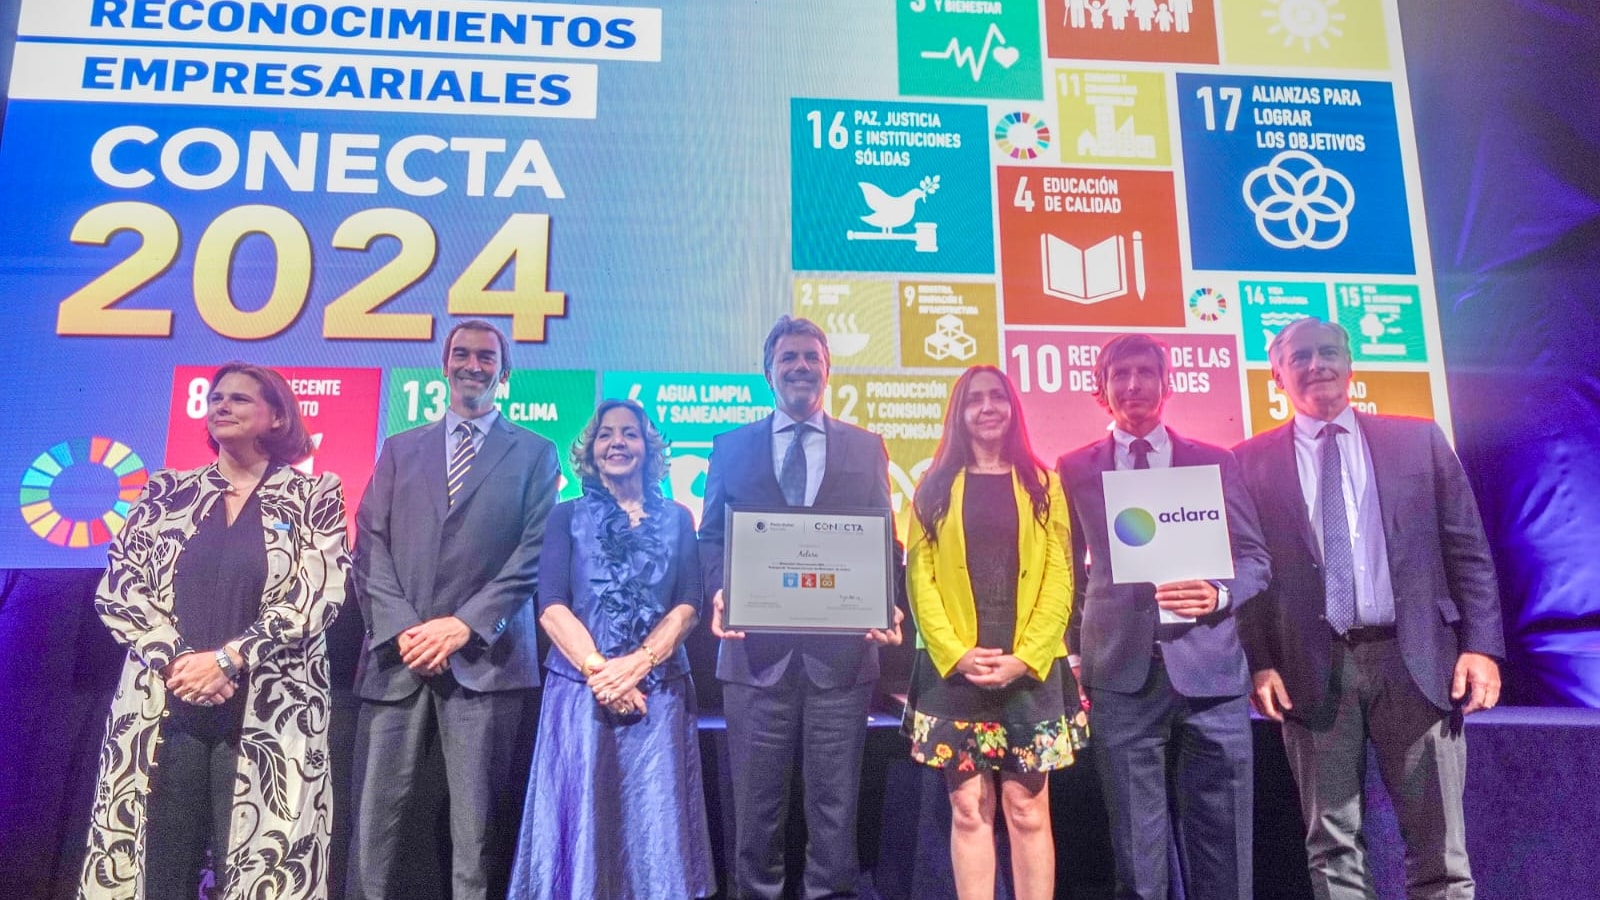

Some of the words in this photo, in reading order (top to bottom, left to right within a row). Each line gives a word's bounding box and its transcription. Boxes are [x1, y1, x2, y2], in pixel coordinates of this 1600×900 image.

[90, 0, 636, 49] RECONOCIMIENTOS
[81, 57, 572, 105] EMPRESARIALES
[1058, 73, 1080, 97] 11
[1252, 85, 1320, 104] ALIANZAS
[1323, 88, 1361, 106] PARA
[1196, 86, 1242, 131] 17
[1254, 108, 1312, 126] LOGRAR
[807, 110, 849, 149] 16
[885, 112, 941, 127] JUSTICIA
[854, 130, 863, 145] E
[866, 131, 961, 148] INSTITUCIONES
[1256, 131, 1285, 148] LOS
[1288, 132, 1365, 151] OBJETIVOS
[91, 125, 565, 198] CONECTA
[855, 148, 910, 166] SÓLIDAS
[1014, 176, 1035, 212] 4
[1043, 176, 1118, 194] EDUCACIÓN
[1044, 195, 1062, 212] DE
[1065, 196, 1122, 213] CALIDAD
[56, 201, 566, 342] 2024
[801, 283, 813, 305] 2
[904, 285, 915, 307] 9
[1244, 285, 1265, 304] 14
[1339, 286, 1361, 307] 15
[1171, 347, 1194, 368] DE
[1197, 348, 1231, 368] LAS
[1011, 344, 1062, 393] 10
[289, 379, 341, 395] ECENTE
[656, 385, 698, 402] AGUA
[701, 386, 752, 403] LIMPIA
[866, 381, 947, 398] PRODUCCIÓN
[186, 377, 209, 419] 8
[403, 380, 447, 421] 13
[1267, 380, 1289, 420] 5
[509, 403, 558, 421] CLIMA
[656, 405, 667, 423] Y
[867, 402, 876, 418] Y
[878, 402, 941, 418] CONSUMO
[1158, 507, 1219, 523] aclara
[814, 522, 865, 532] CONCTA
